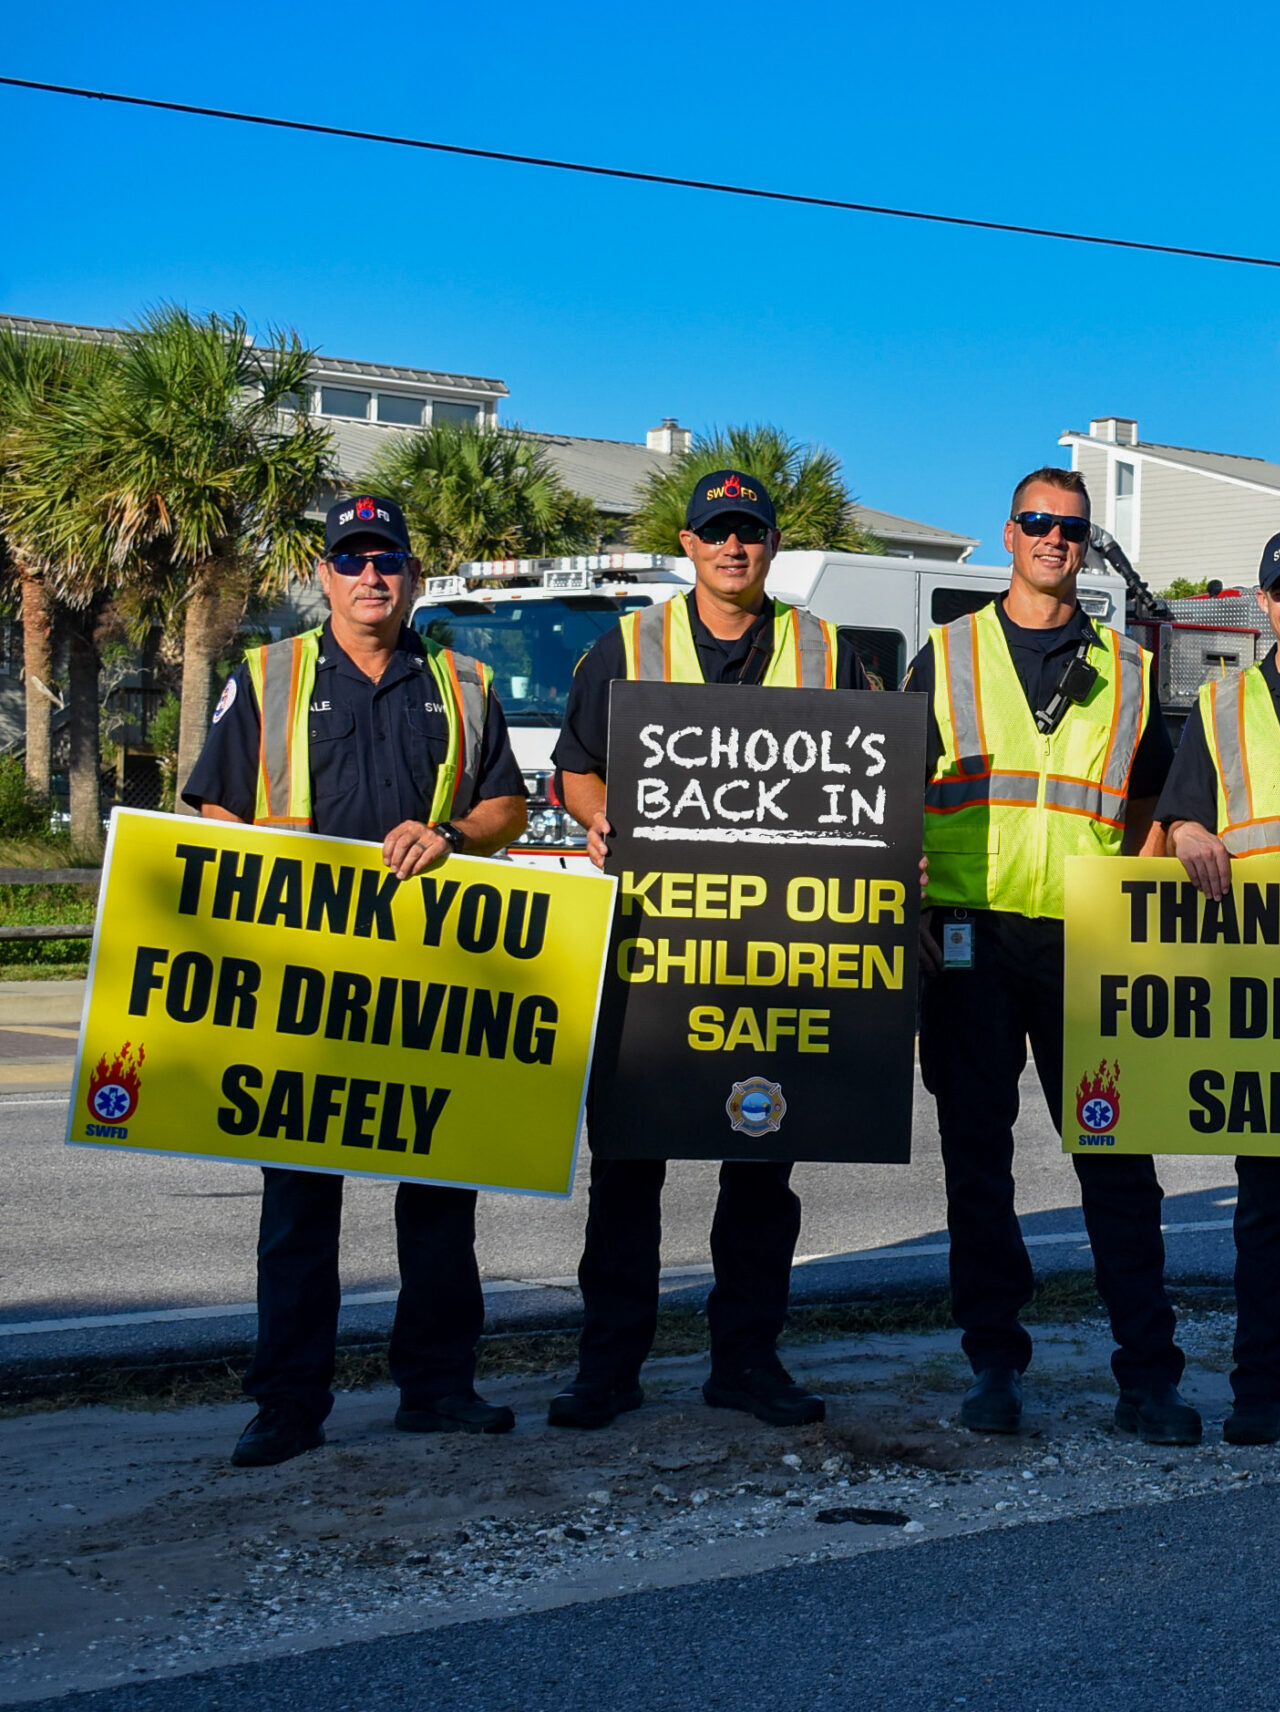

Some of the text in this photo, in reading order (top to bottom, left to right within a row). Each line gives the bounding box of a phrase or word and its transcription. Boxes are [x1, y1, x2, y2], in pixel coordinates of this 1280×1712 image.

[638, 723, 887, 776] SCHOOL'S
[637, 777, 887, 826] BACK IN
[174, 843, 551, 959] THANK YOU
[621, 871, 906, 924] KEEP OUR
[616, 937, 904, 990] CHILDREN
[128, 945, 559, 1065] FOR DRIVING
[688, 1005, 830, 1053] SAFE
[1100, 973, 1211, 1039] FOR
[85, 1123, 129, 1140] SWFD
[217, 1063, 451, 1155] SAFELY
[1078, 1134, 1116, 1147] SWFD
